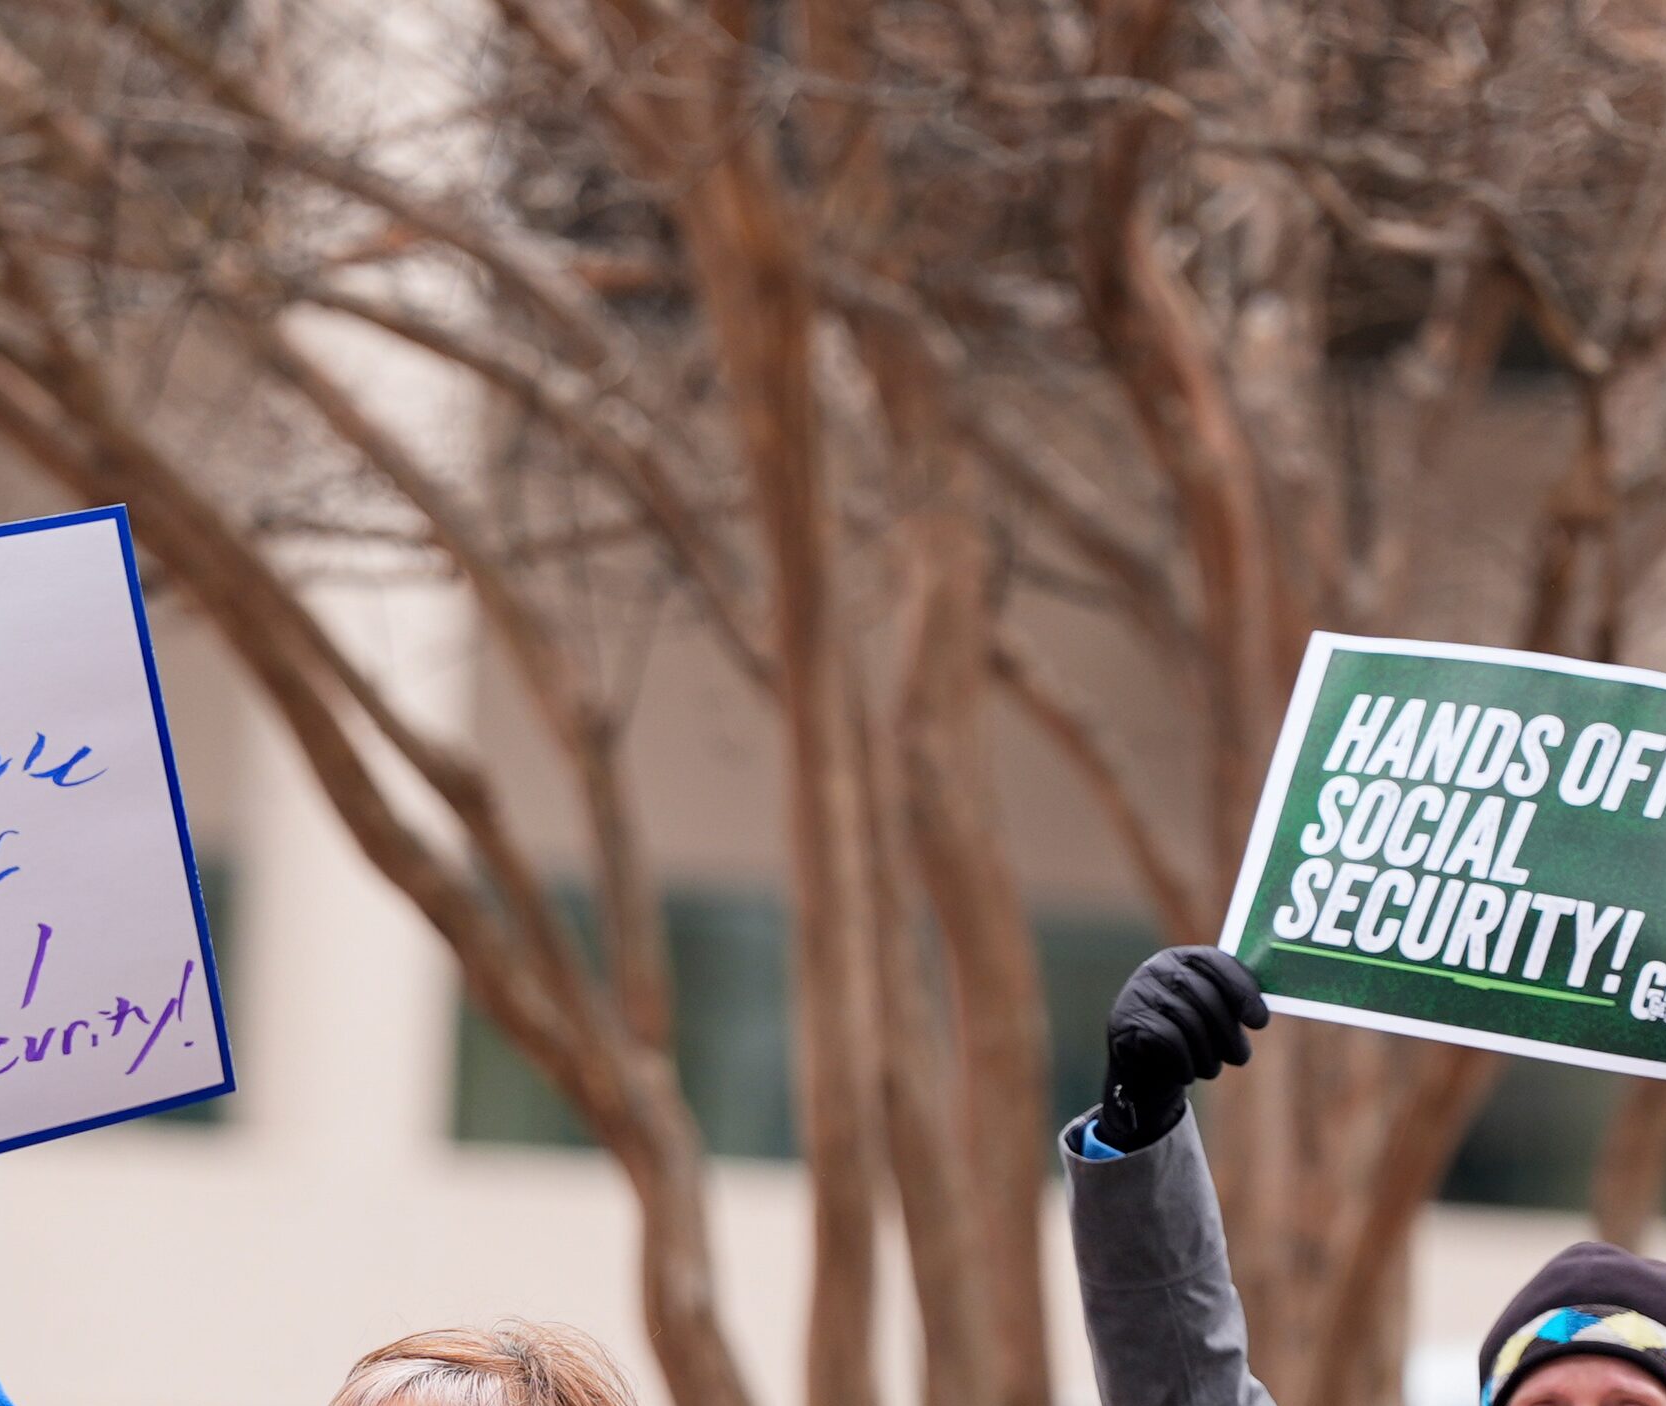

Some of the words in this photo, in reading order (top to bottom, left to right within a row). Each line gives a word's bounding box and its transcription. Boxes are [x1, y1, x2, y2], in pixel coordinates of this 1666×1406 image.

[1323, 693, 1566, 798] HANDS
[1299, 776, 1537, 885] SOCIAL
[1273, 858, 1646, 994] SECURITY!
